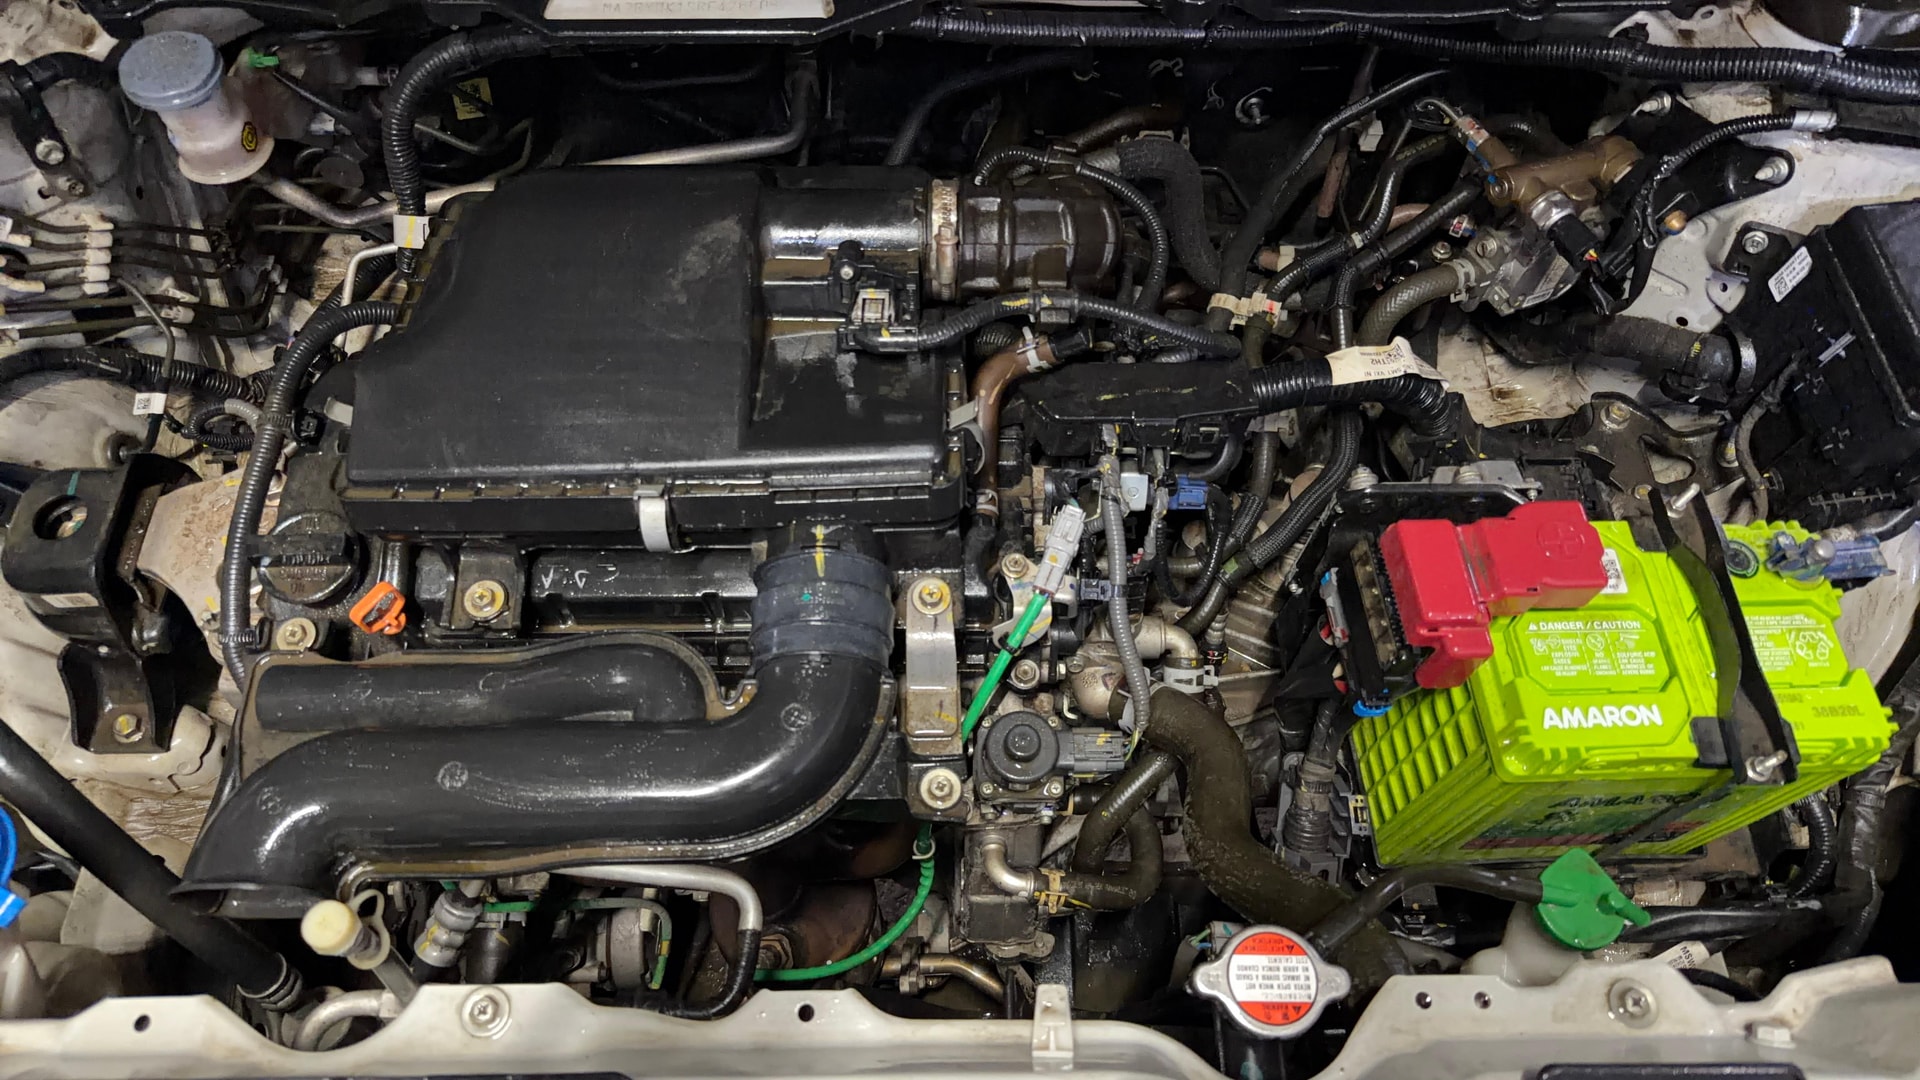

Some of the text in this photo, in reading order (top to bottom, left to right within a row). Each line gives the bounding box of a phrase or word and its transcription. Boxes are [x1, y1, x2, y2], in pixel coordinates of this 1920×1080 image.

[1539, 621, 1584, 631] DANGER
[1593, 620, 1641, 630] CAUTION
[1543, 704, 1663, 730] AMARON
